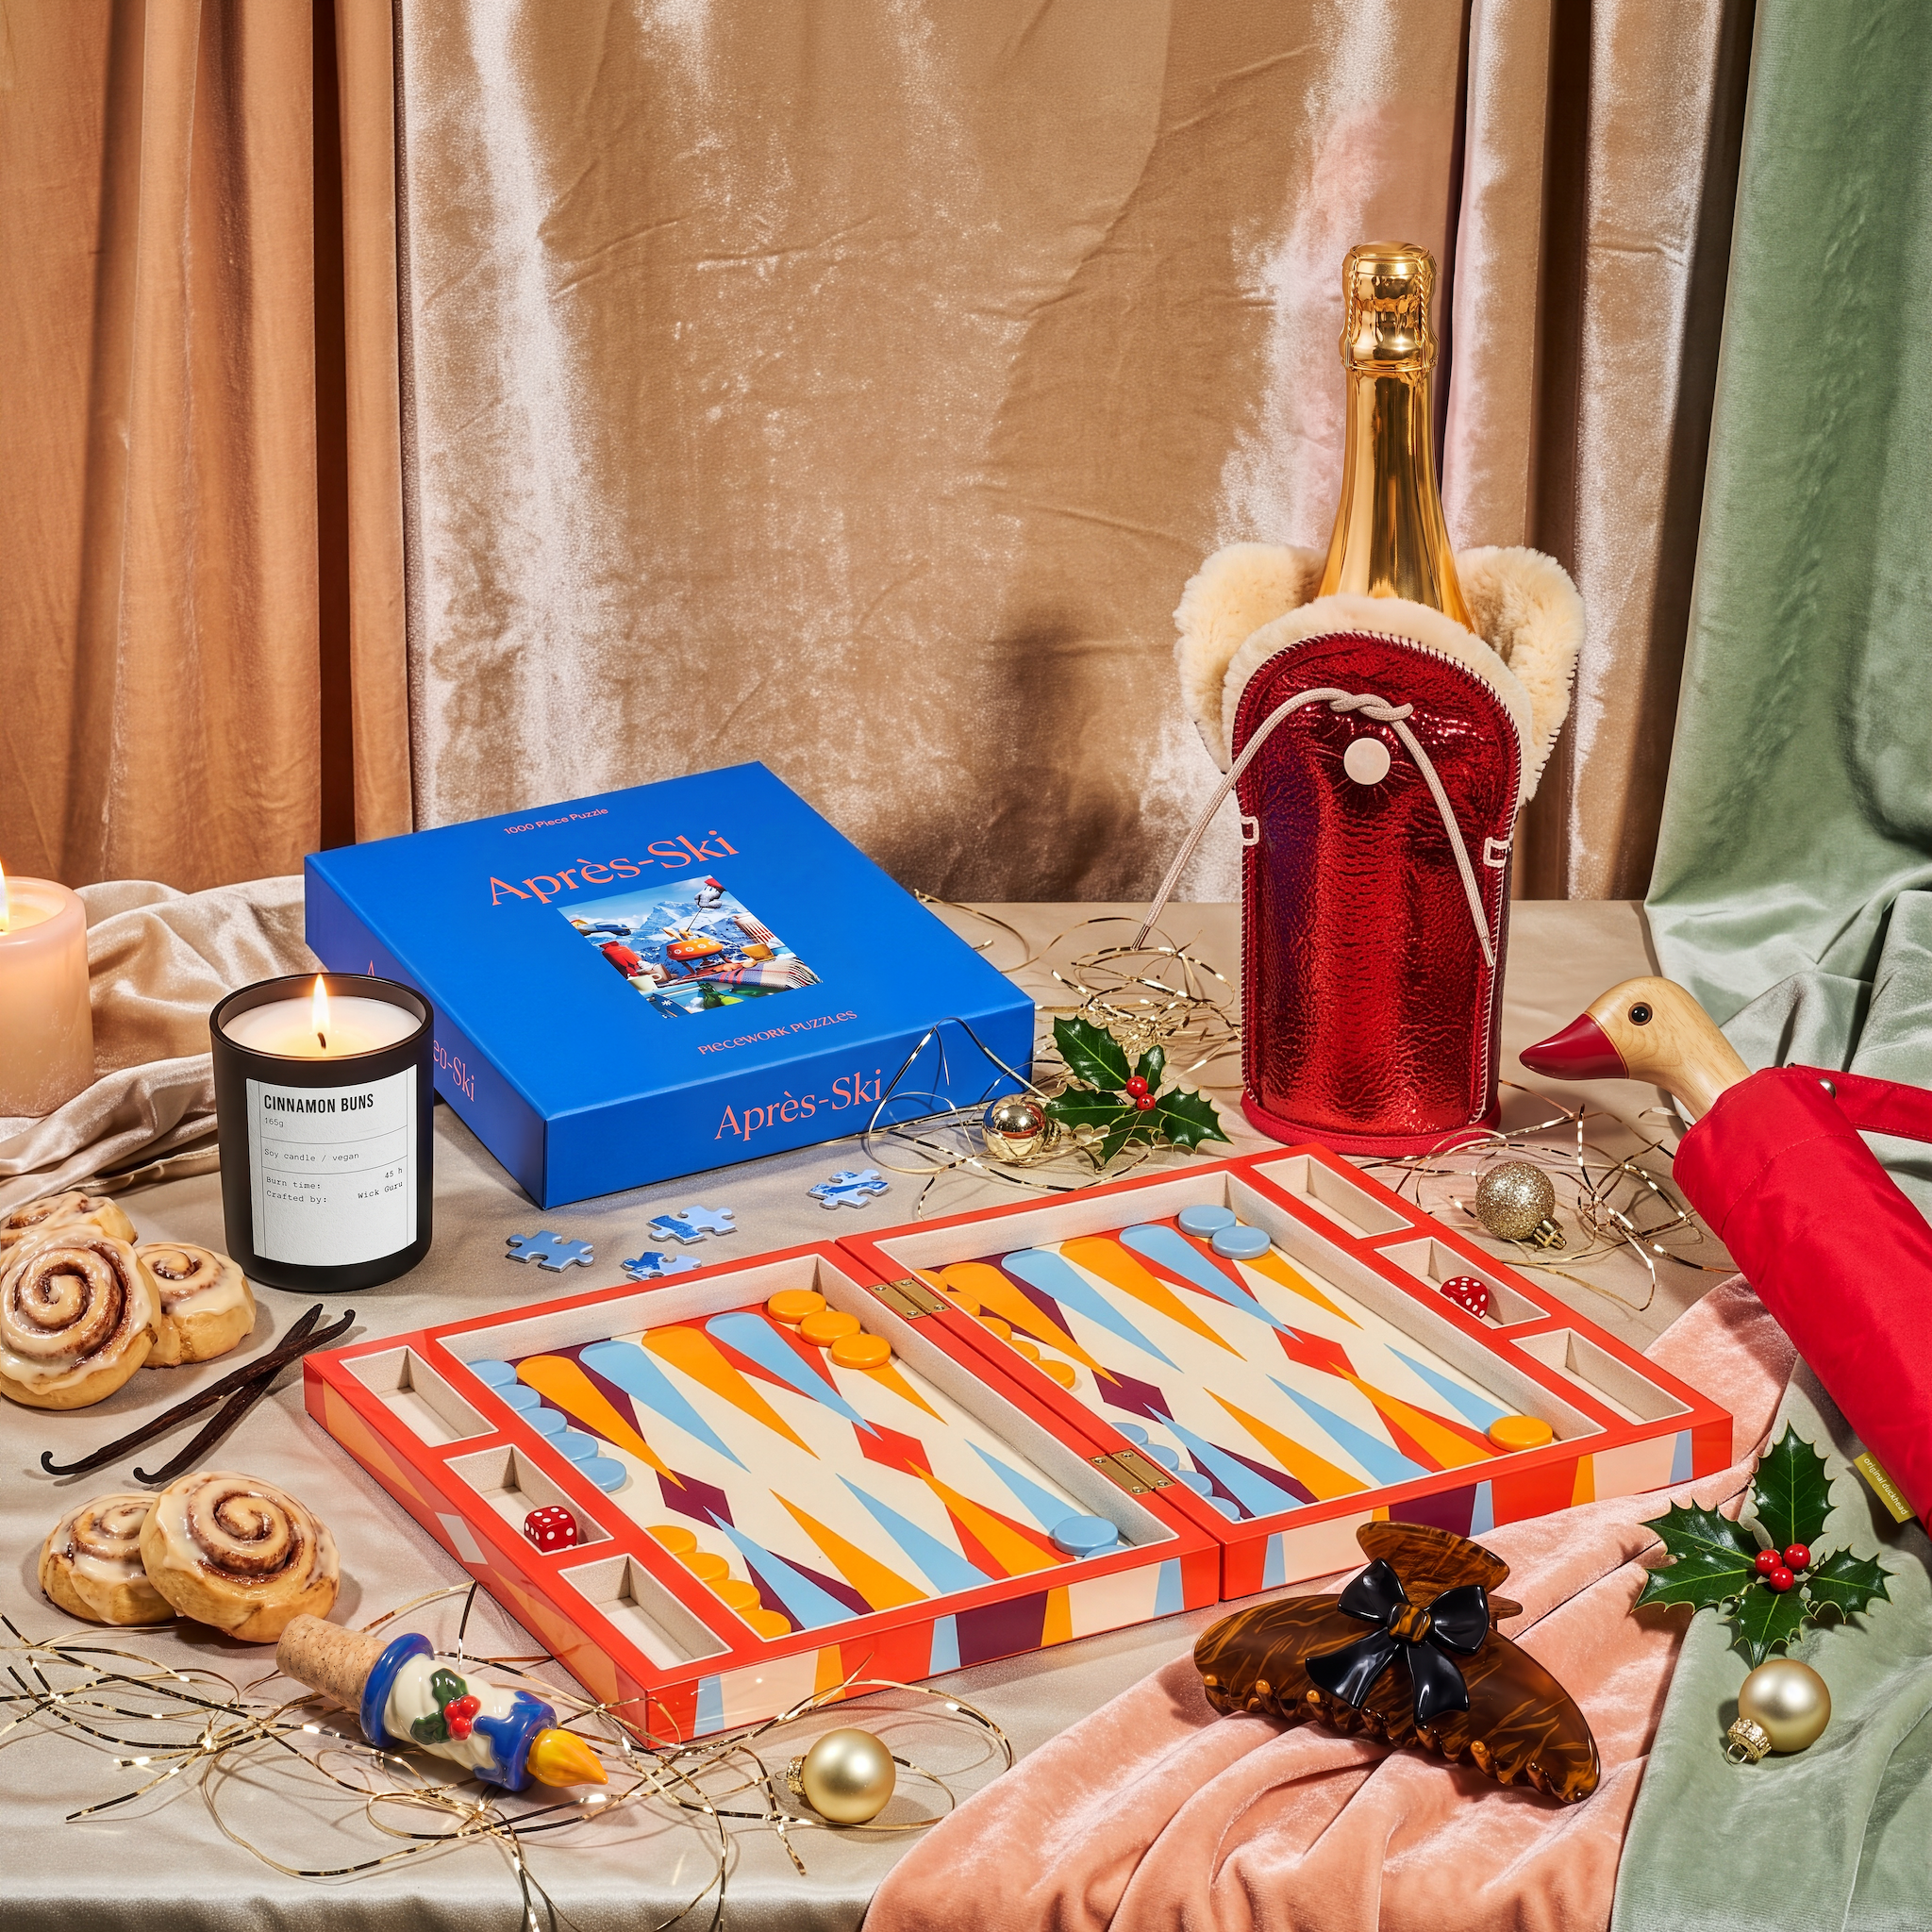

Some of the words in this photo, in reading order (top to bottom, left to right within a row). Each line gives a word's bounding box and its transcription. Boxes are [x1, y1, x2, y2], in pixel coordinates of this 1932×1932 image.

[504, 823, 535, 835] 1000
[535, 817, 570, 828] Piece
[569, 808, 609, 821] Puzzle
[489, 829, 740, 907] Après-Ski
[263, 1094, 336, 1114] CINNAMON
[341, 1093, 374, 1112] BUNS
[714, 1068, 882, 1142] Après-Ski
[264, 1117, 284, 1128] 165g
[264, 1148, 279, 1159] Soy
[283, 1152, 316, 1162] candle
[332, 1152, 359, 1162] vegan
[266, 1175, 288, 1188] Burn
[292, 1180, 322, 1190] time:
[384, 1170, 394, 1179] 45
[266, 1190, 304, 1203] Crafted
[309, 1194, 327, 1205] by:
[358, 1189, 379, 1199] Wick
[384, 1181, 403, 1192] Guru
[1863, 1457, 1887, 1484] original
[1881, 1482, 1909, 1515] duckhead
